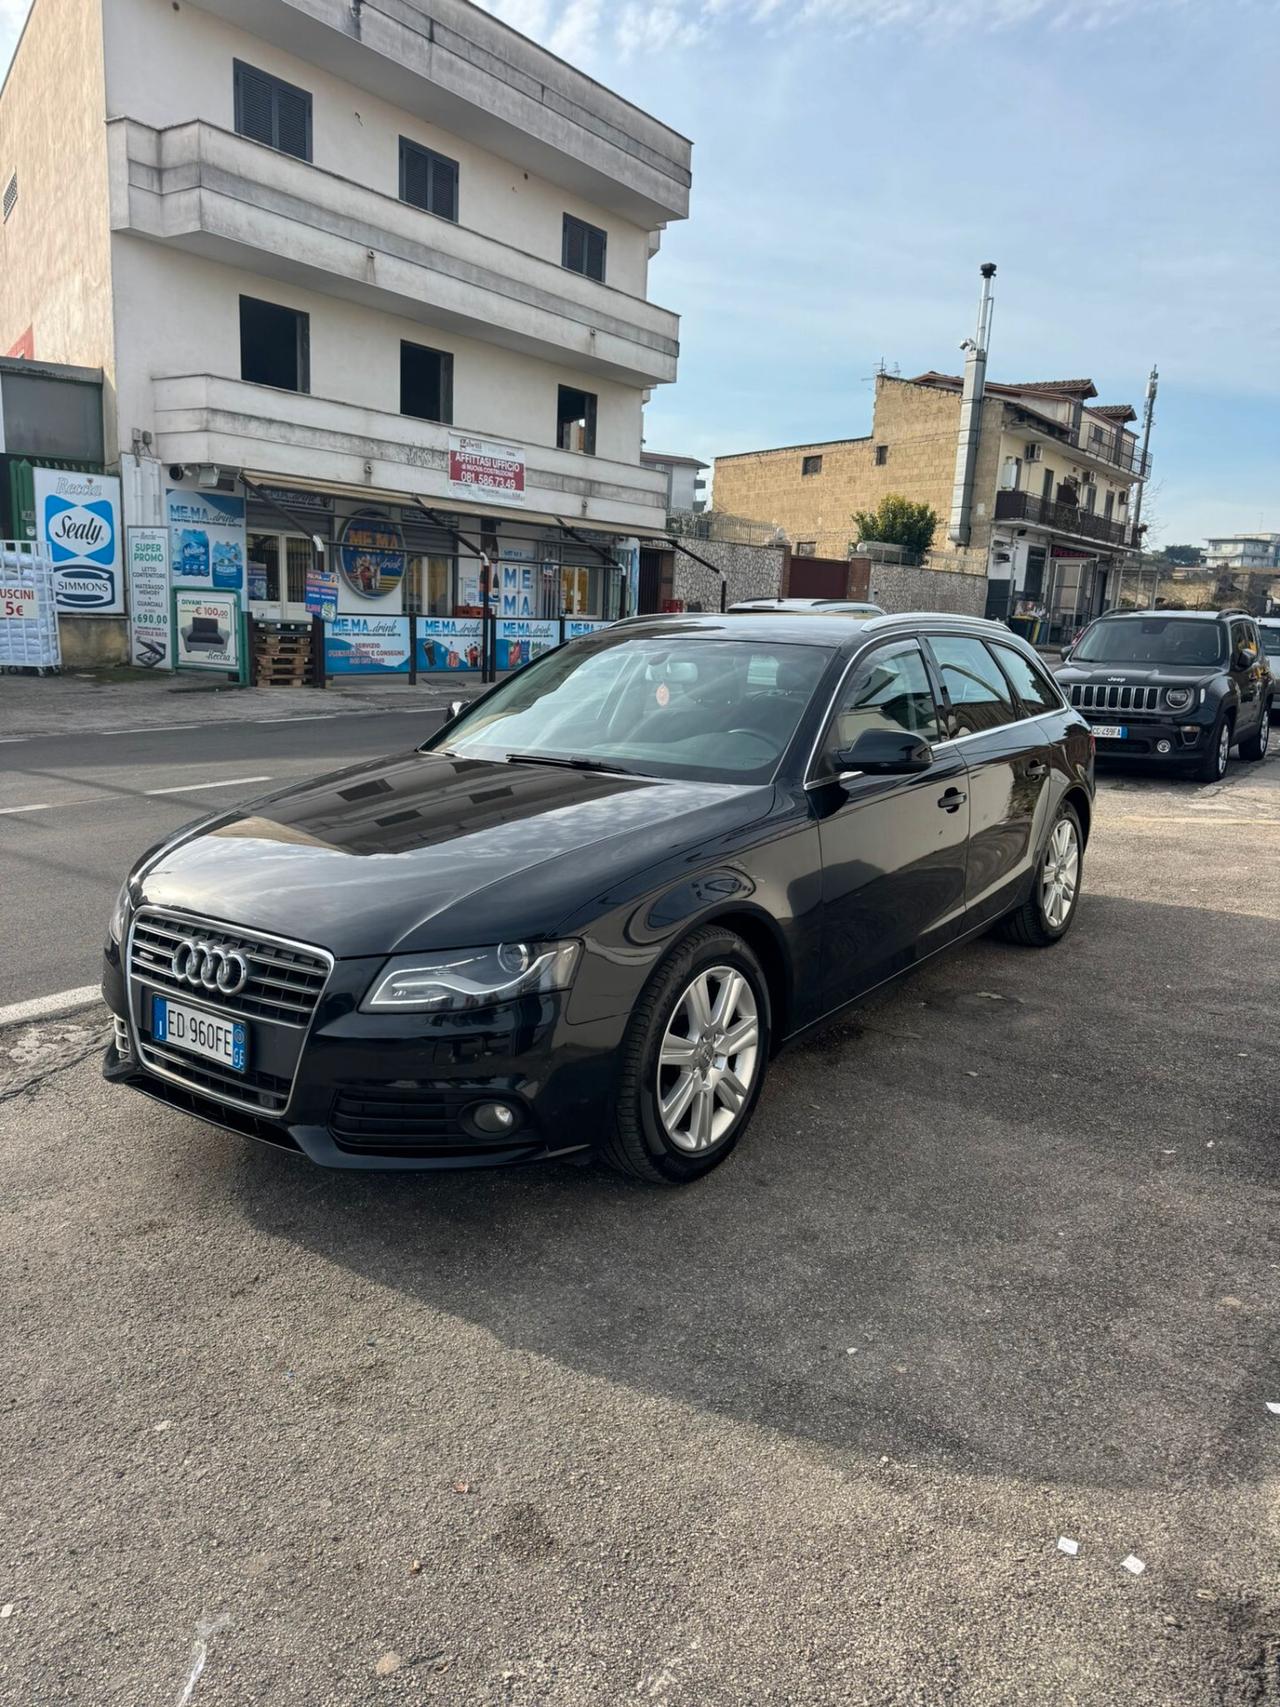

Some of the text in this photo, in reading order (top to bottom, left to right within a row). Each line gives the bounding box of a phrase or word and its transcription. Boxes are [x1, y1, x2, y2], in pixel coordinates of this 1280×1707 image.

[455, 452, 491, 465] AFFITTASI
[492, 458, 519, 472] UFFICIO
[55, 515, 102, 545] Sealy
[134, 543, 161, 552] SUPER
[133, 553, 163, 562] PROMO
[58, 581, 108, 592] SIMMONS
[5, 601, 24, 616] 5€
[168, 1010, 232, 1057] ED 960FE
[234, 1048, 245, 1065] GE
